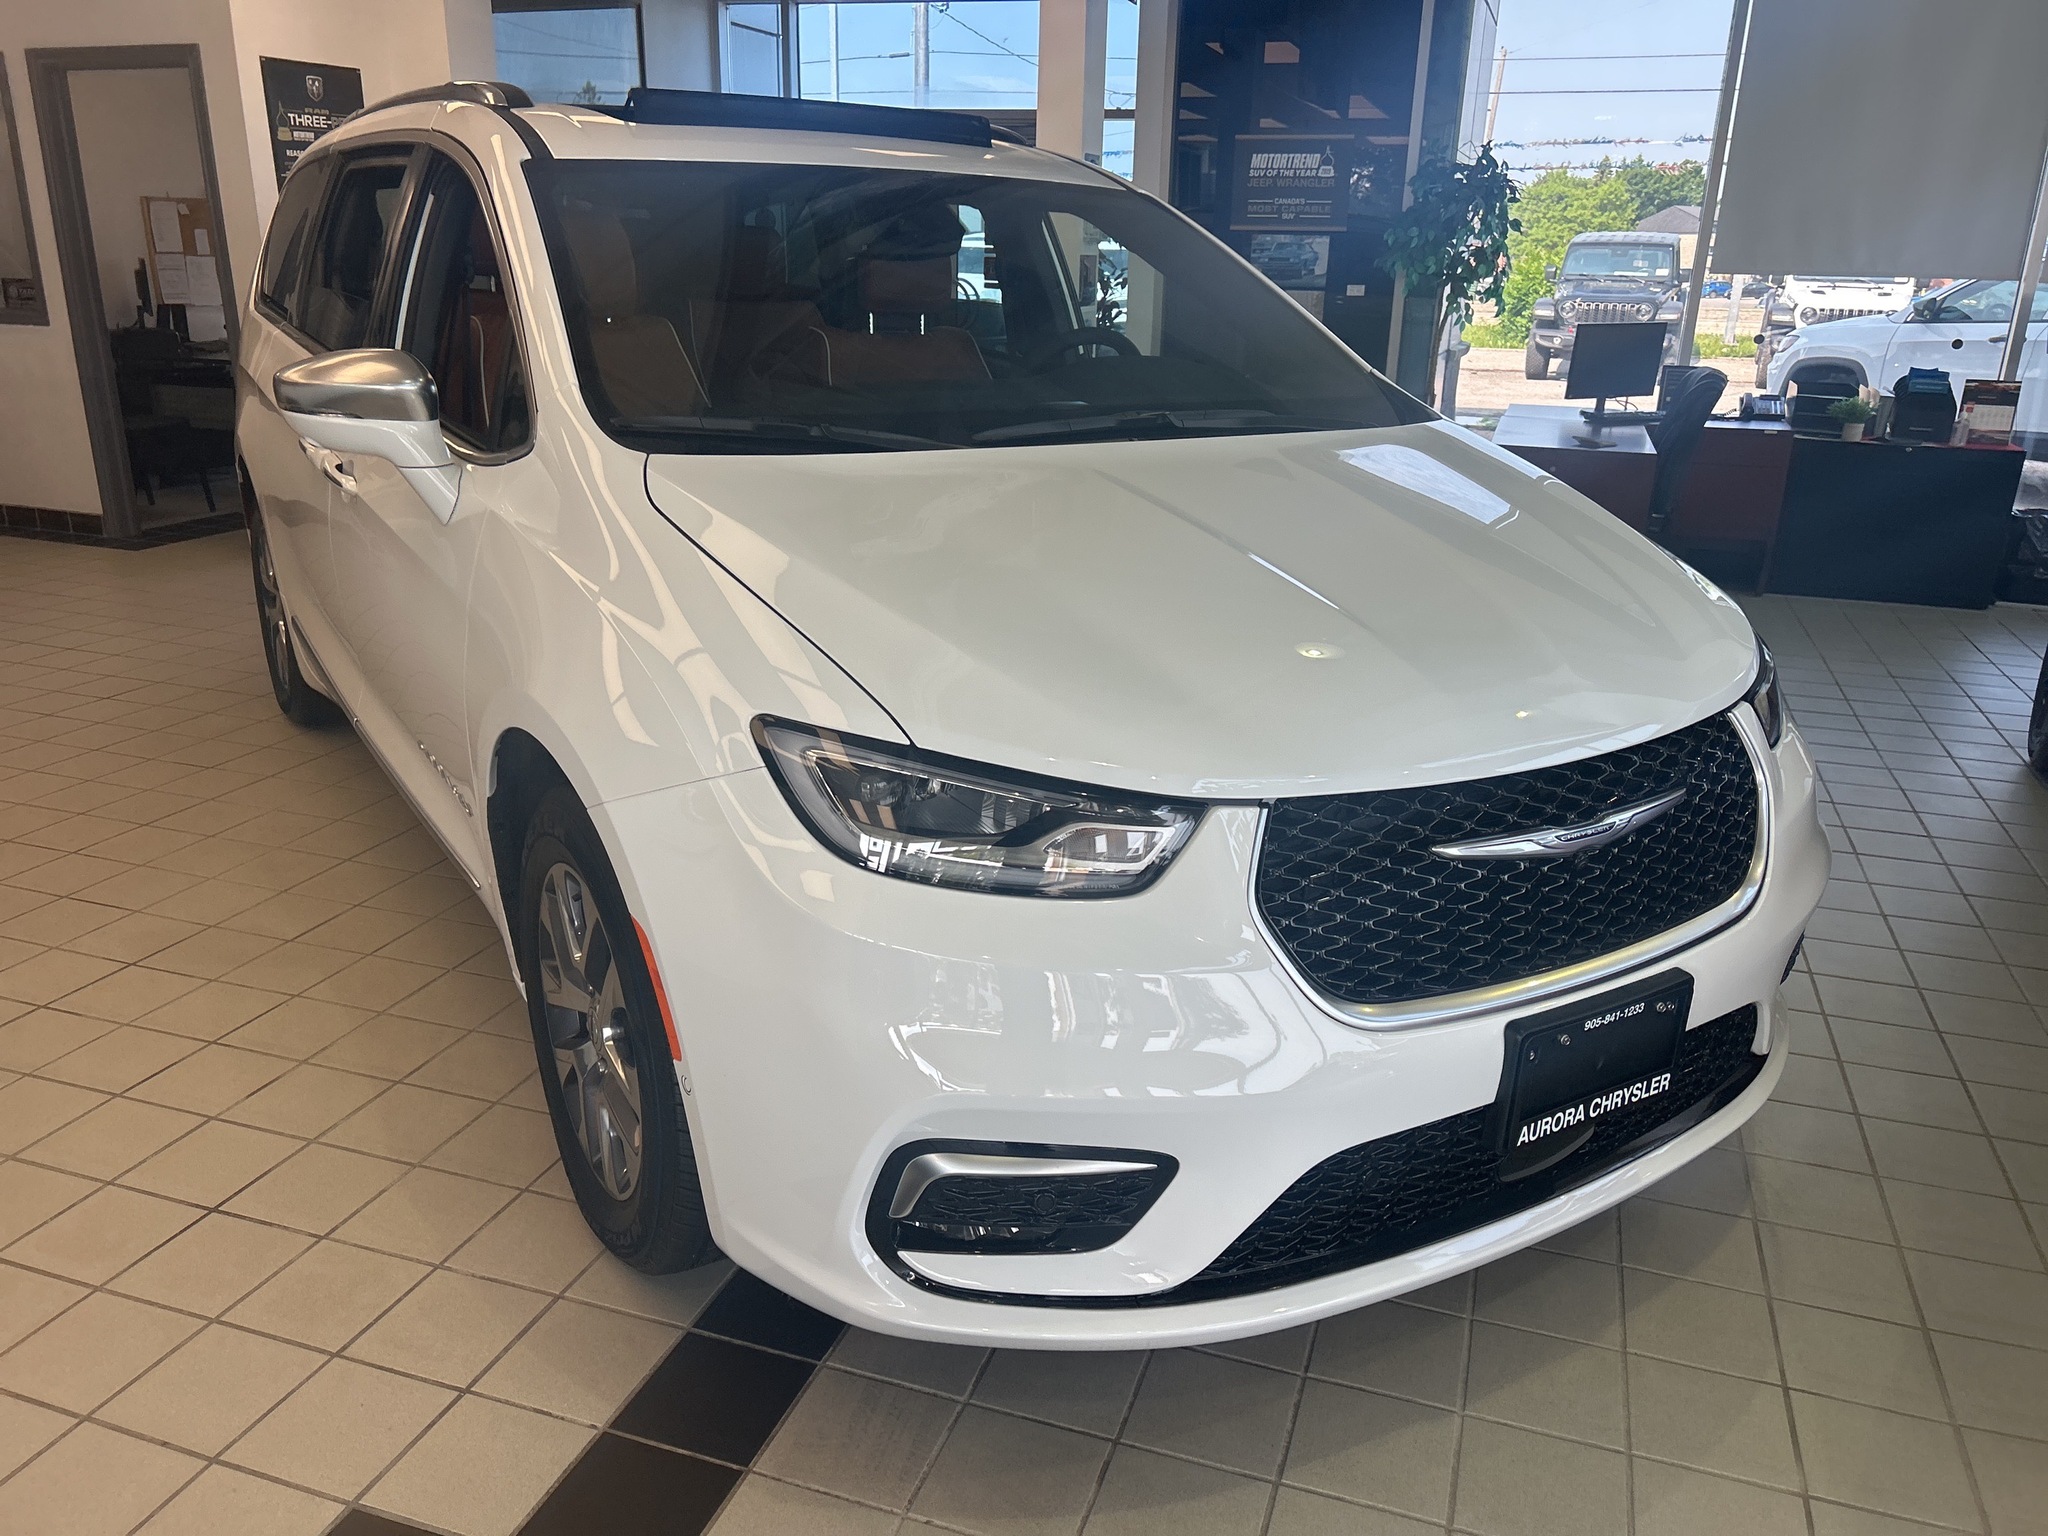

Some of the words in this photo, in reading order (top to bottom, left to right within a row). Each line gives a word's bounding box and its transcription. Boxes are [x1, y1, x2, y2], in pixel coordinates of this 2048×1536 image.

[1250, 153, 1320, 168] MOTORTREND
[1248, 169, 1266, 177] SUV
[1266, 169, 1279, 177] OF
[1279, 169, 1295, 177] THE
[1295, 169, 1317, 177] YEAR
[1247, 178, 1272, 188] JEEP
[1276, 178, 1335, 188] WRANGLER
[1247, 205, 1279, 213] MOST
[1281, 205, 1331, 213] CAPABLE
[1560, 825, 1610, 842] CHRYSLER
[1584, 1002, 1645, 1031] 905-841-1233
[1517, 1104, 1585, 1147] AURORA
[1589, 1073, 1671, 1118] CHRYSLER
